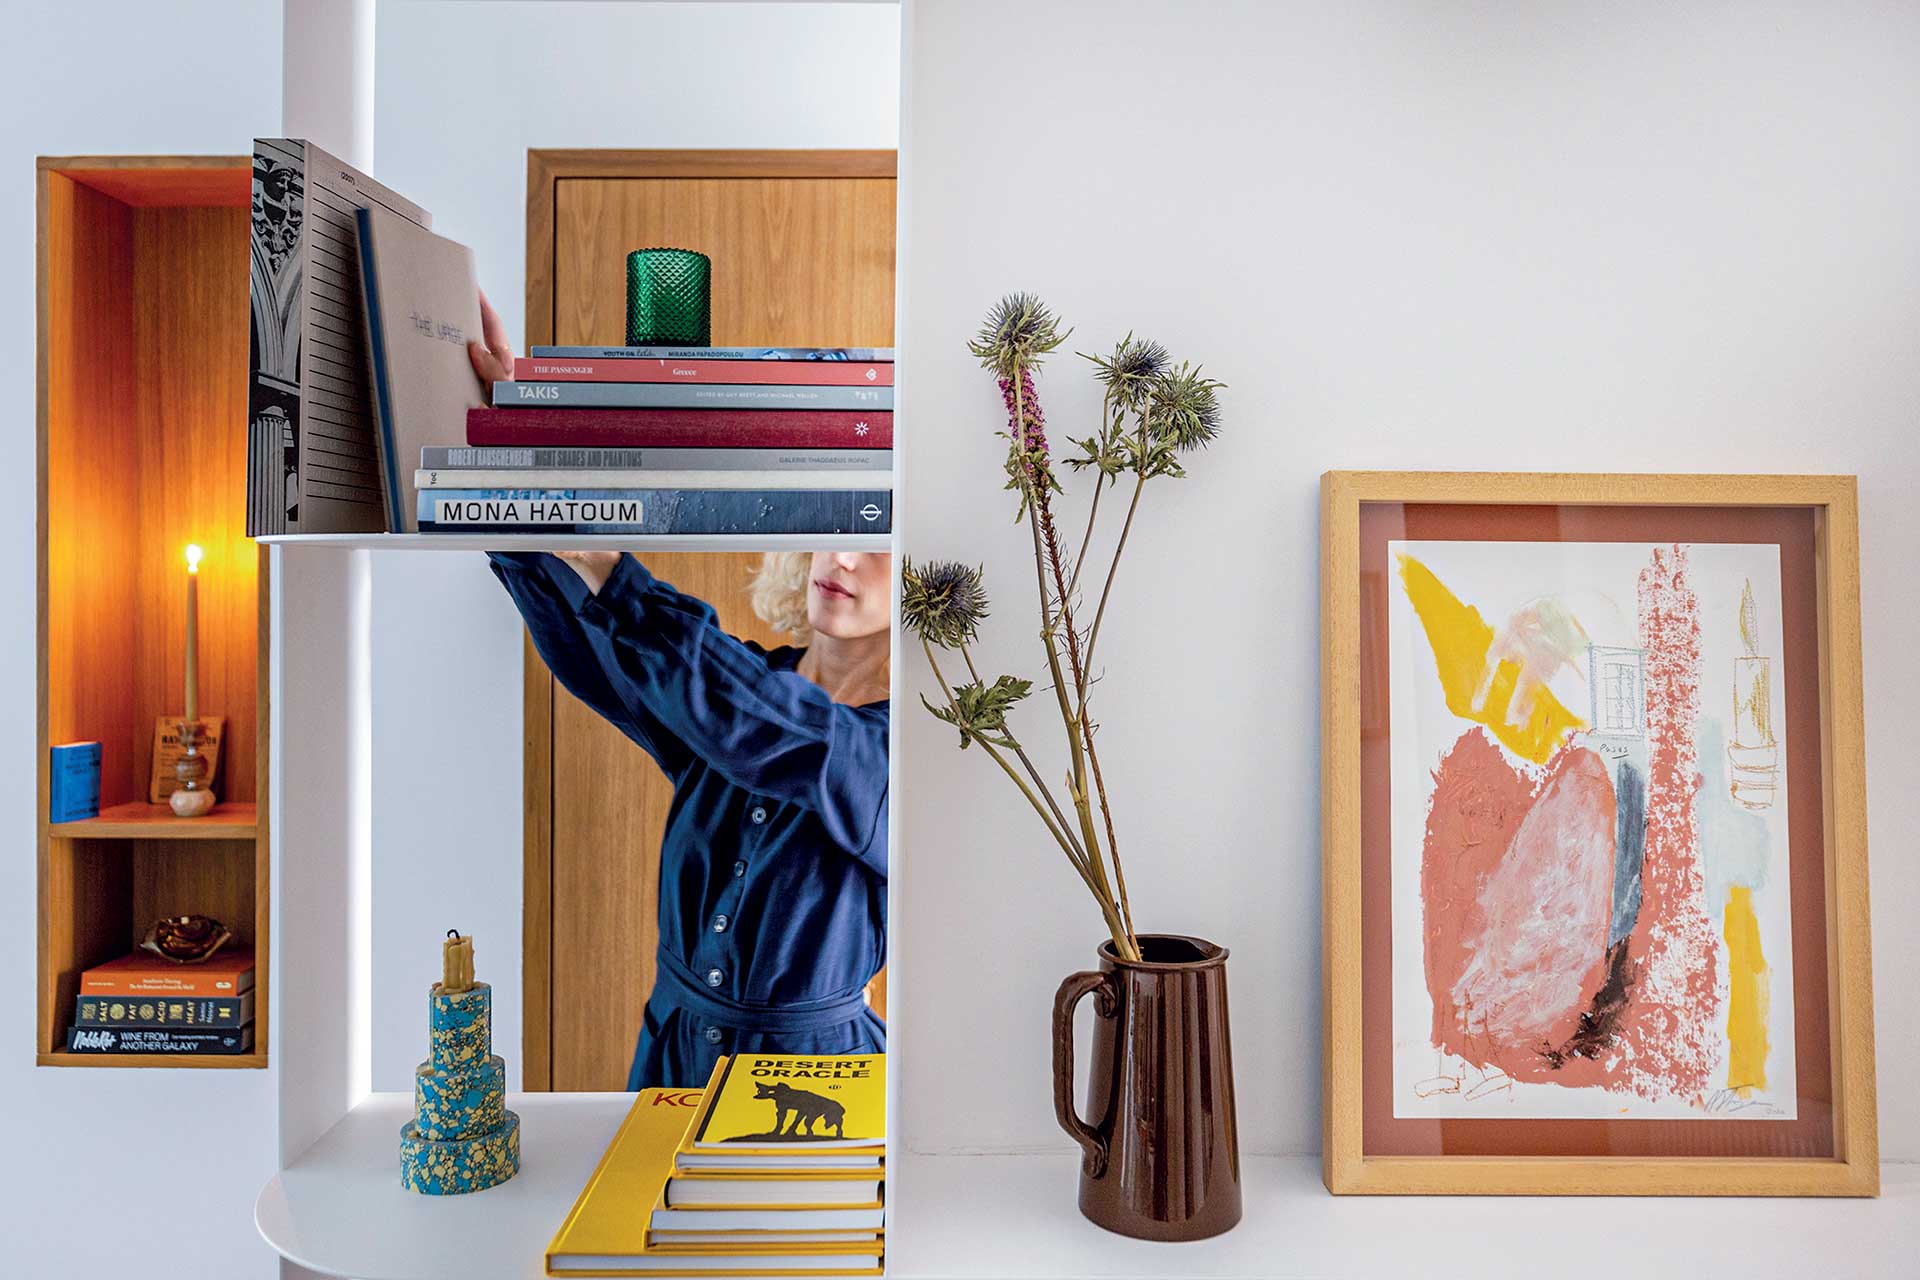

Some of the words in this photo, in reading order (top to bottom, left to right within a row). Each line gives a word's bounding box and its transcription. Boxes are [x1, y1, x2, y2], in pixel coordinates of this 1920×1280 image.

[533, 365, 550, 374] THE
[550, 365, 593, 375] PASSENGER
[672, 367, 697, 376] Greece
[517, 386, 559, 400] TAKIS
[443, 502, 519, 521] MONA
[530, 502, 637, 521] HATOUM
[119, 1032, 143, 1041] WINE
[143, 1032, 169, 1041] FROM
[119, 1041, 161, 1051] ANOTHER
[162, 1041, 199, 1051] GALAXY
[754, 1059, 872, 1069] DESERT
[750, 1068, 870, 1079] ORACLE
